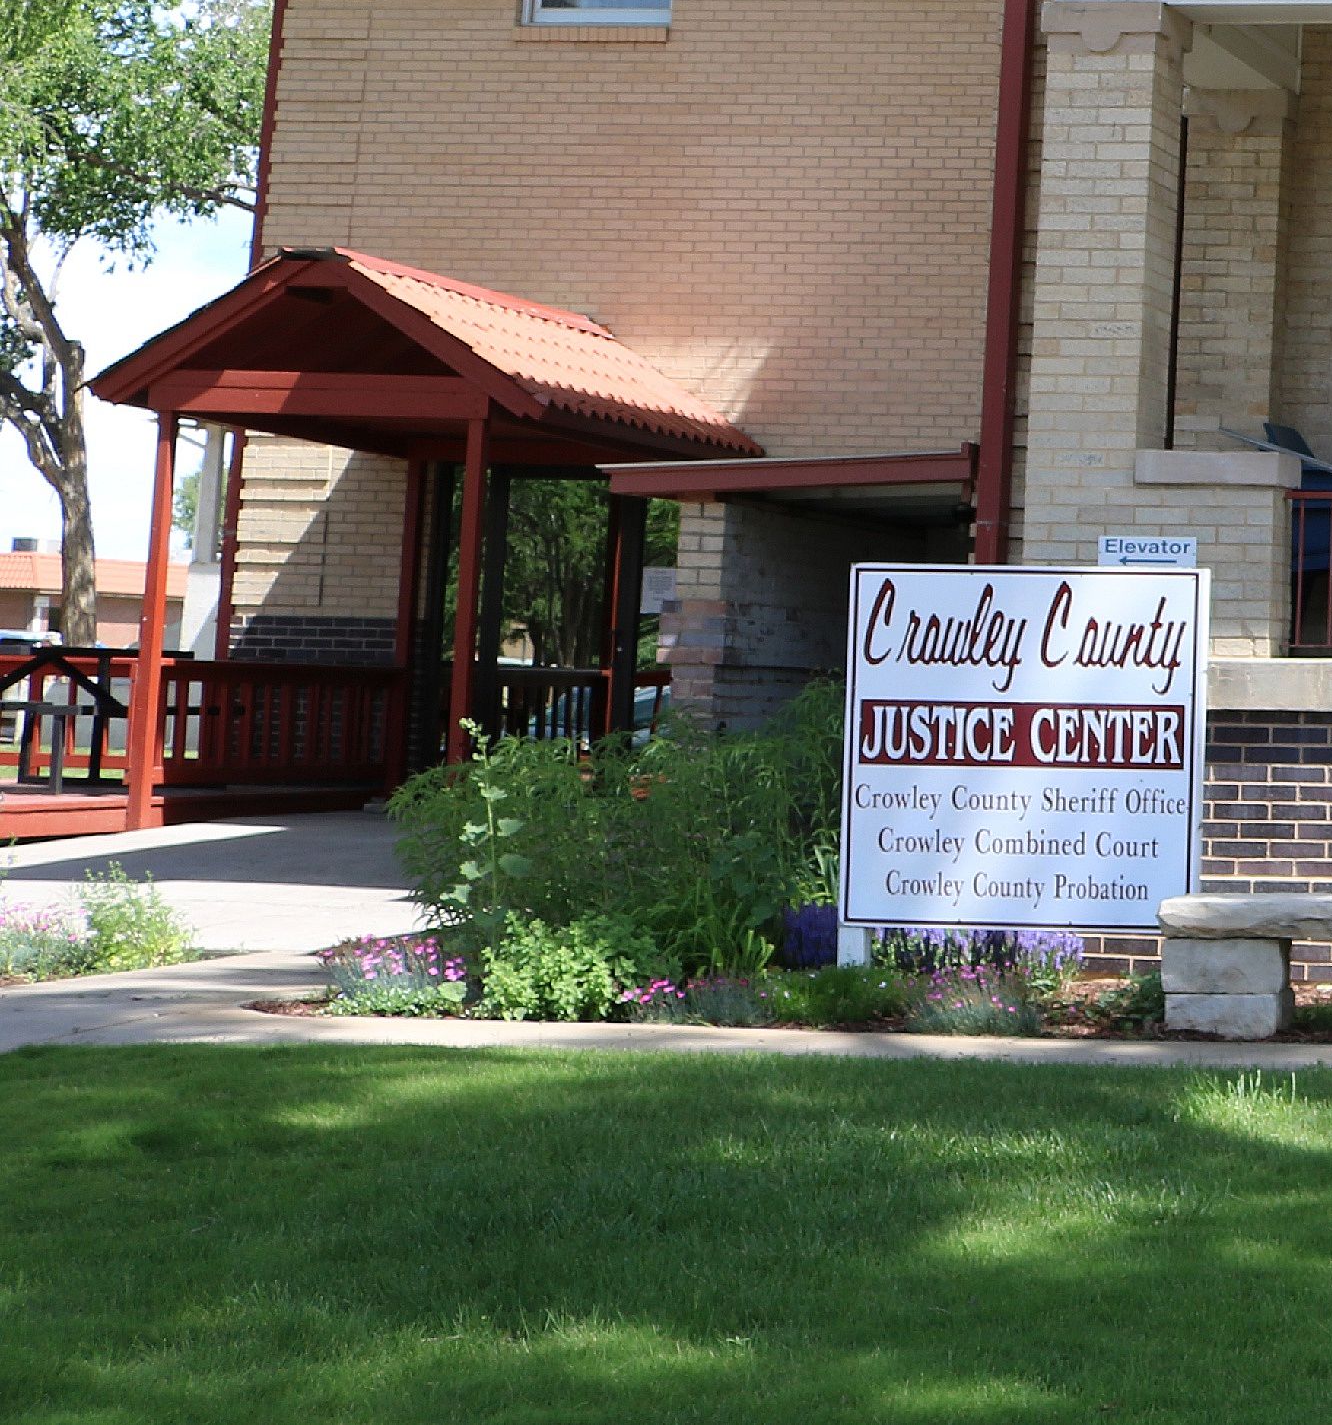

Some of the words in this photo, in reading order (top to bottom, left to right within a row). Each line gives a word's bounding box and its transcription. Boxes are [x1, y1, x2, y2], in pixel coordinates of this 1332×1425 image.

[1105, 538, 1191, 554] Elevator
[863, 578, 1028, 693] Crowley
[1040, 580, 1187, 695] County
[861, 705, 1016, 762] JUSTICE
[1029, 708, 1181, 764] CENTER
[855, 784, 942, 820] Crowley
[951, 784, 1032, 820] County
[1040, 787, 1119, 814] Sheriff
[1125, 788, 1186, 815] Office
[878, 827, 965, 863] Crowley
[974, 828, 1086, 856] Combined
[1095, 831, 1160, 858] Court
[885, 869, 964, 906] Crowley
[973, 871, 1046, 909] County
[1053, 873, 1149, 901] Probation
